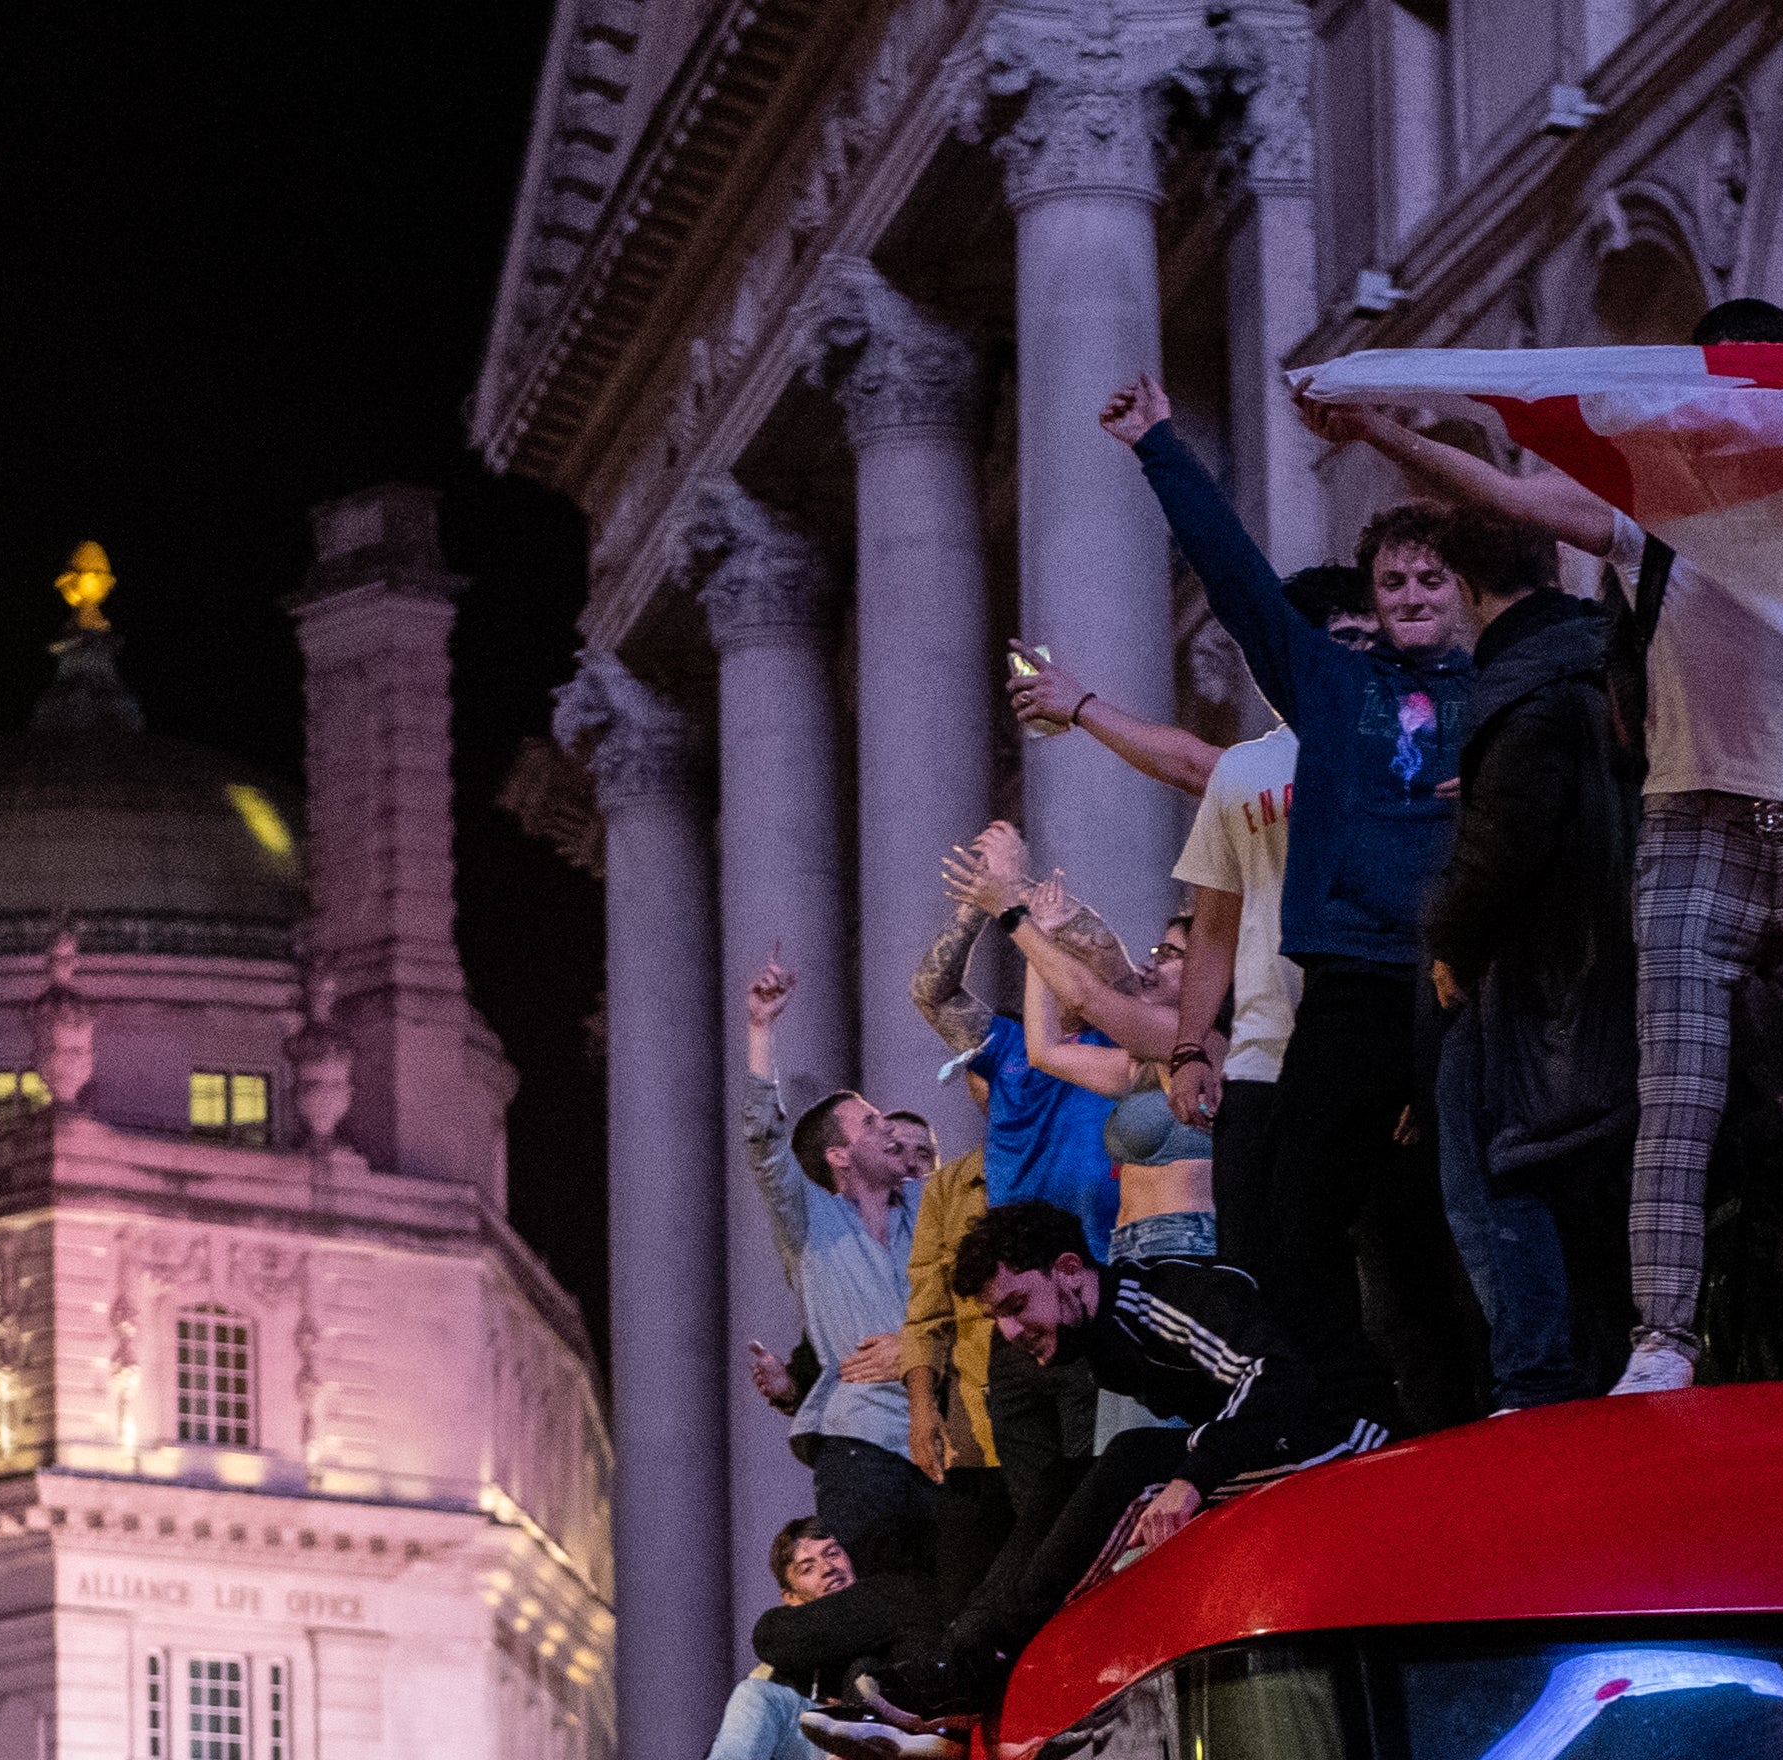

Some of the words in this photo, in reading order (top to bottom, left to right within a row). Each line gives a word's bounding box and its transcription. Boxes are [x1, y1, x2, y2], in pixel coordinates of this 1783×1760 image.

[78, 1575, 191, 1607] ALLIANCE
[215, 1583, 263, 1615] LIFE
[285, 1590, 364, 1622] OFFICE
